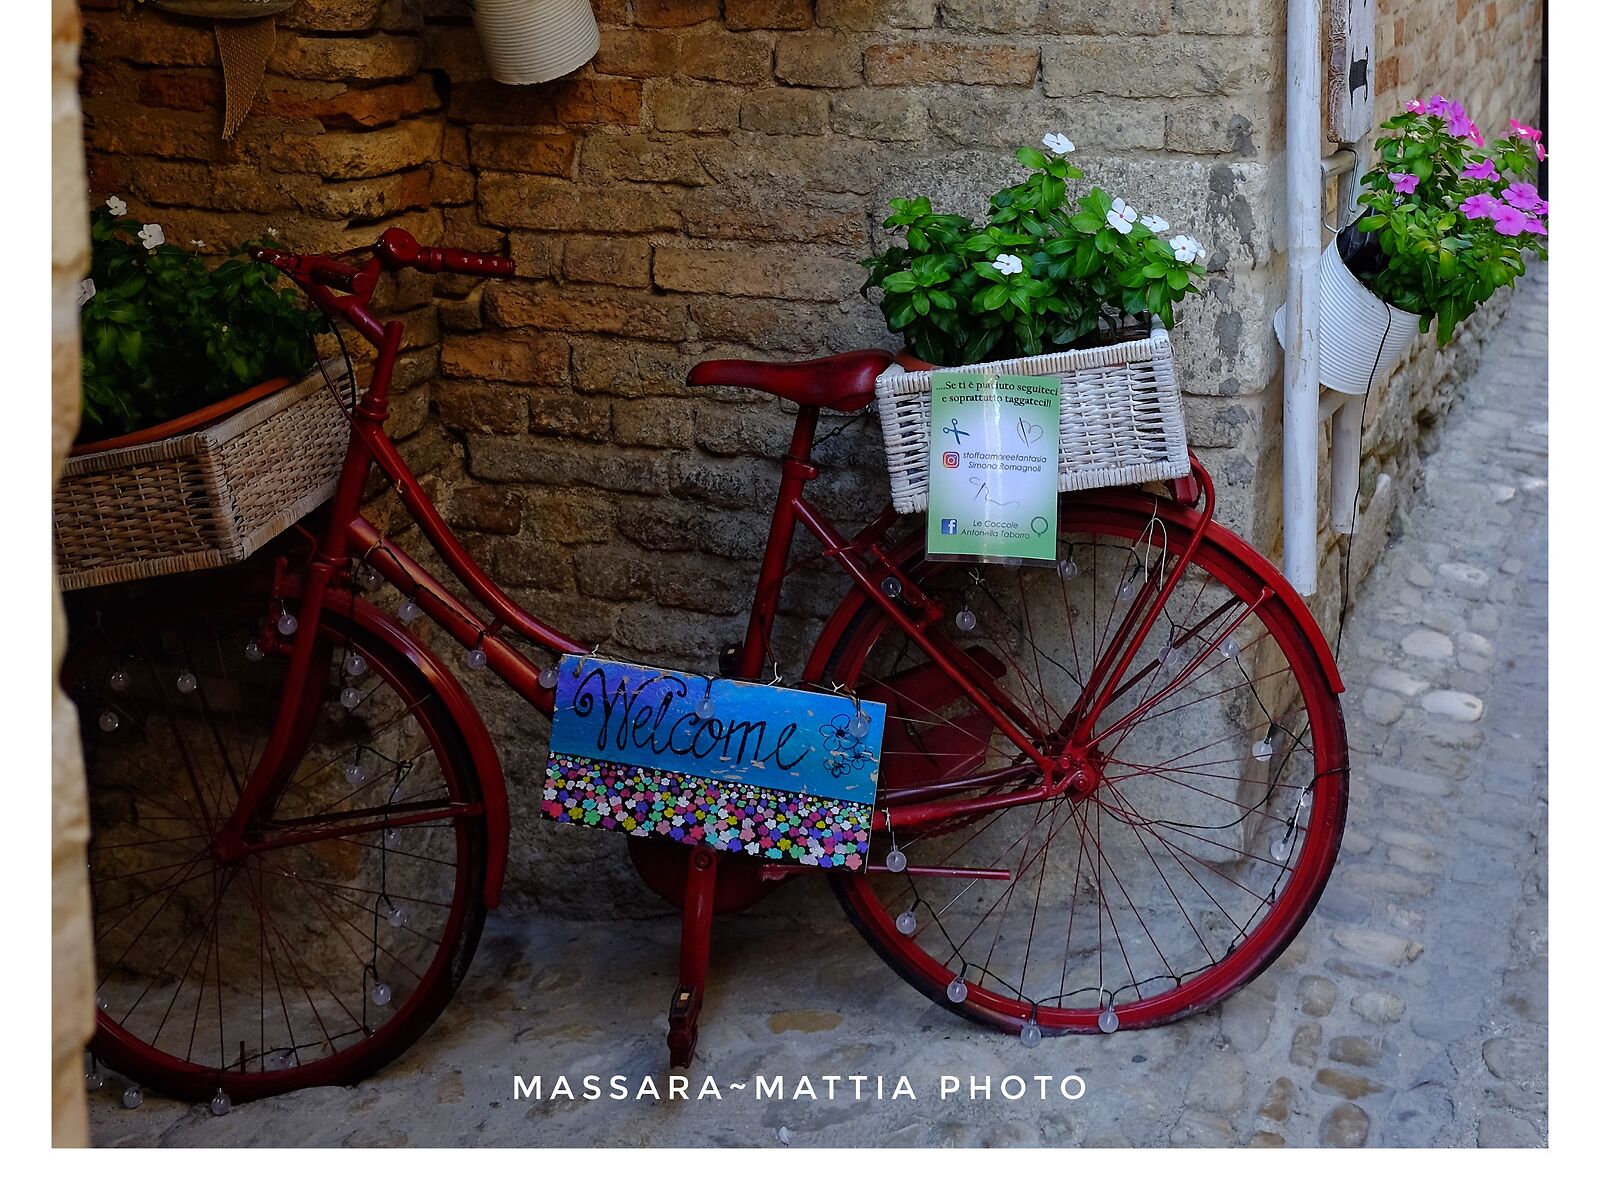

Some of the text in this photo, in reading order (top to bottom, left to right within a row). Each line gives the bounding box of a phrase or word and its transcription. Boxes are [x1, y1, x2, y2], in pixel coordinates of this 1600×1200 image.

[958, 380, 966, 390] ti
[968, 381, 974, 389] è
[1016, 383, 1059, 396] seguiteci
[1000, 463, 1042, 473] Romagnoli
[972, 519, 1019, 529] Le Coccole
[573, 667, 809, 771] Welcome
